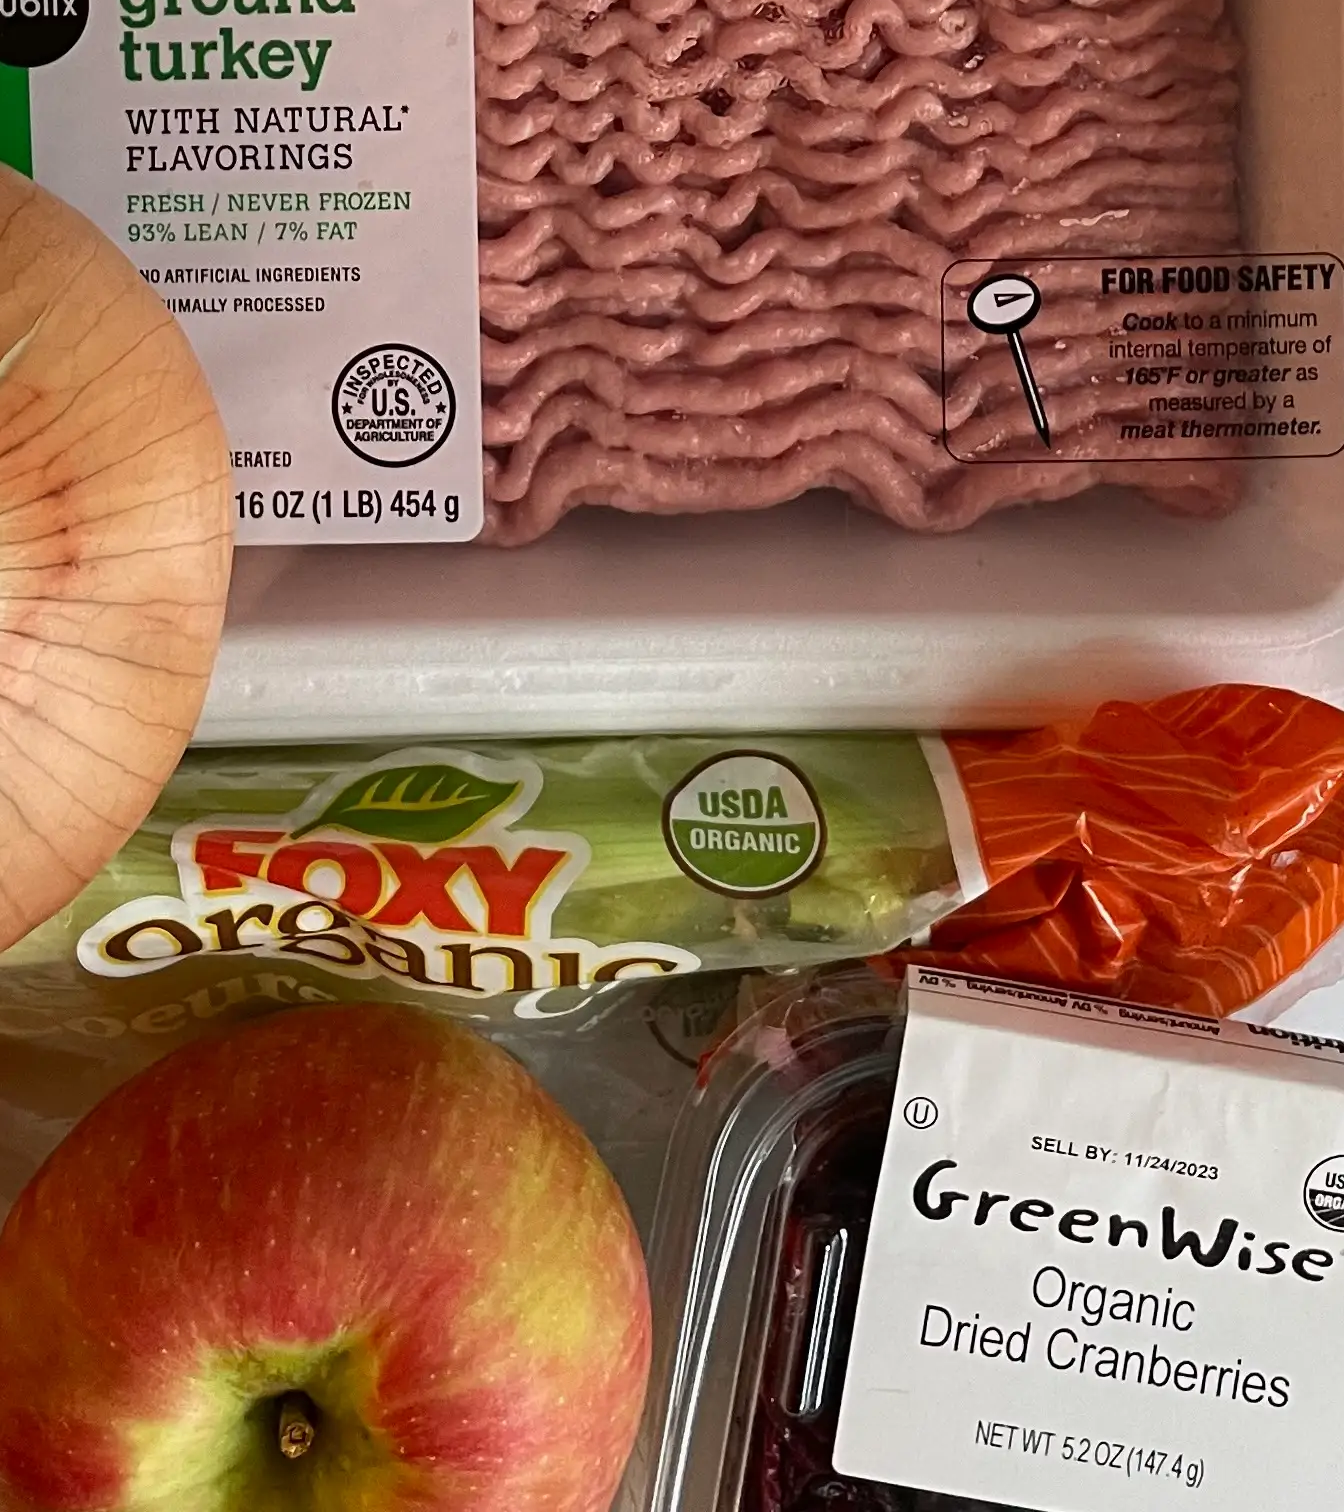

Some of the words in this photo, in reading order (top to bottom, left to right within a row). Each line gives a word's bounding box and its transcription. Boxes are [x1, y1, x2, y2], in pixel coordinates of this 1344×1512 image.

[119, 27, 332, 91] turkey
[126, 108, 220, 135] WITH
[126, 143, 354, 172] FLAVORINGS
[127, 194, 205, 214] FRESH
[227, 192, 310, 212] NEVER
[319, 191, 411, 212] FROZEN
[128, 223, 176, 243] 93%
[184, 223, 248, 242] LEAN
[275, 222, 308, 241] 7%
[316, 221, 358, 240] FAT
[164, 268, 251, 284] ARTIFICIAL
[256, 267, 361, 283] INGREDIENTS
[1101, 267, 1154, 294] FOR
[1161, 266, 1230, 294] FOOD
[1238, 263, 1336, 291] SAFETY
[233, 296, 325, 313] PROCESSED
[1122, 312, 1179, 332] Cook
[1227, 310, 1318, 330] minimum
[1108, 339, 1182, 359] internal
[1187, 338, 1307, 362] temperature
[342, 354, 443, 398] INSPECTED
[1213, 366, 1292, 390] greater
[372, 388, 416, 416] U.S.
[1149, 392, 1247, 413] measured
[346, 418, 424, 430] DEPARTMENT
[354, 430, 435, 442] AGRICULTURE
[1120, 421, 1175, 440] meat
[1181, 418, 1322, 439] thermometer.
[234, 490, 264, 519] 16
[272, 490, 305, 519] OZ
[343, 489, 383, 522] LB)
[389, 489, 437, 518] 454
[697, 786, 789, 819] USDA
[690, 827, 801, 854] ORGANIC
[194, 829, 570, 938] FOXY
[1030, 1135, 1080, 1159] SELL
[1086, 1143, 1119, 1165] BY:
[1123, 1151, 1219, 1181] 11/24/2023
[912, 1159, 1335, 1283] GreenWise
[1033, 1265, 1196, 1332] Organic
[920, 1305, 1031, 1364] Dried
[1047, 1327, 1290, 1409] Cranberries
[975, 1420, 1020, 1451] NET
[1021, 1426, 1057, 1457] WT
[1061, 1436, 1092, 1464] 5.2
[1094, 1440, 1126, 1470] OZ
